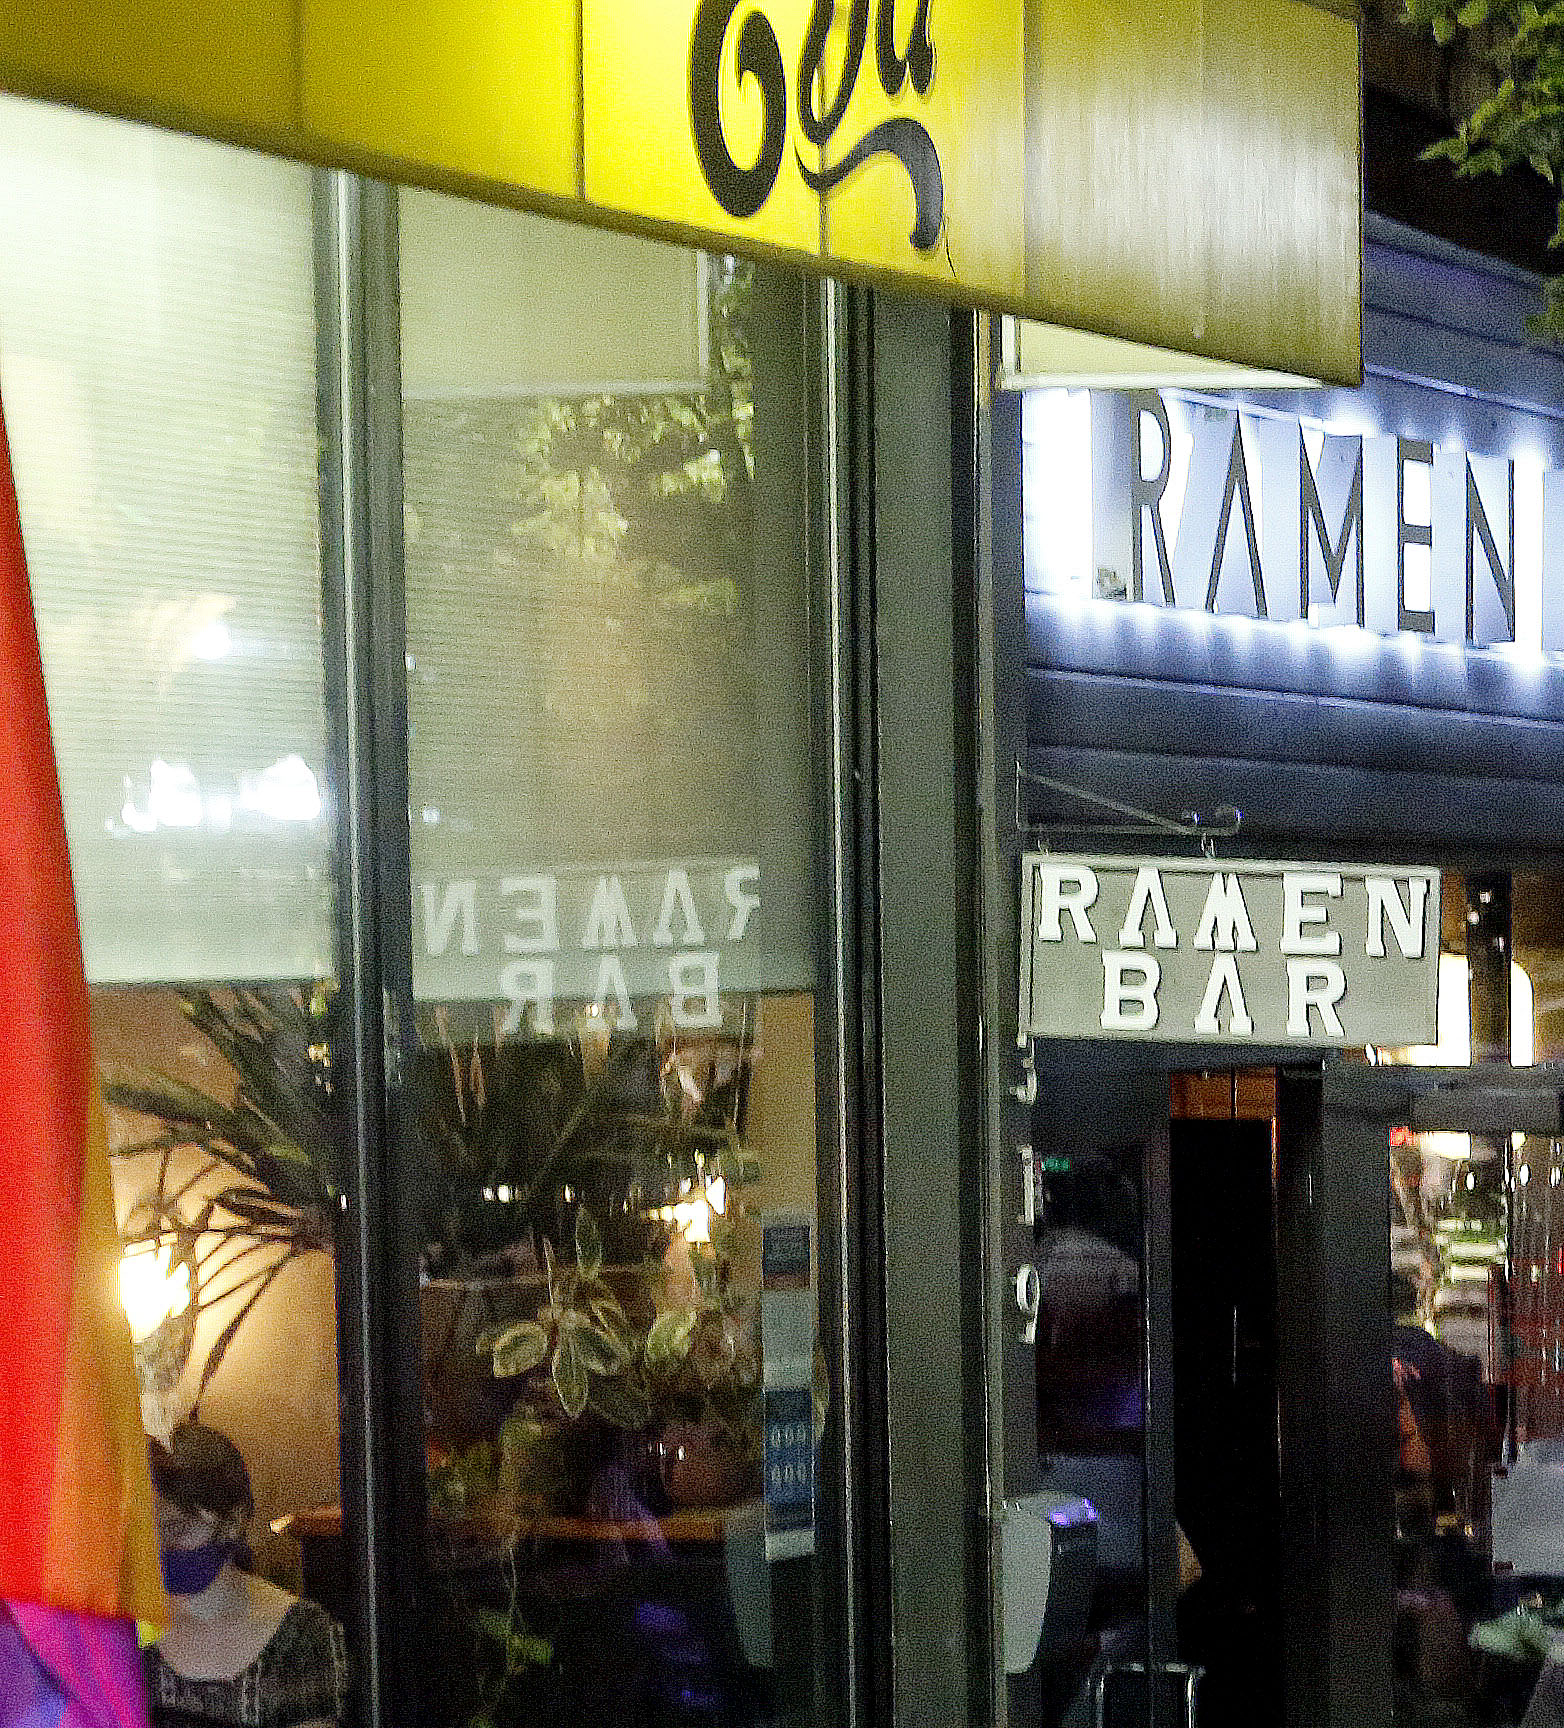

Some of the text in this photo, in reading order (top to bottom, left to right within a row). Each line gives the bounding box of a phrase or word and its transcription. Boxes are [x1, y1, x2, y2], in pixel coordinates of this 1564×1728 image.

[1131, 388, 1516, 645] RAMEN
[1038, 862, 1428, 958] RAMEN
[1100, 949, 1347, 1037] BAR
